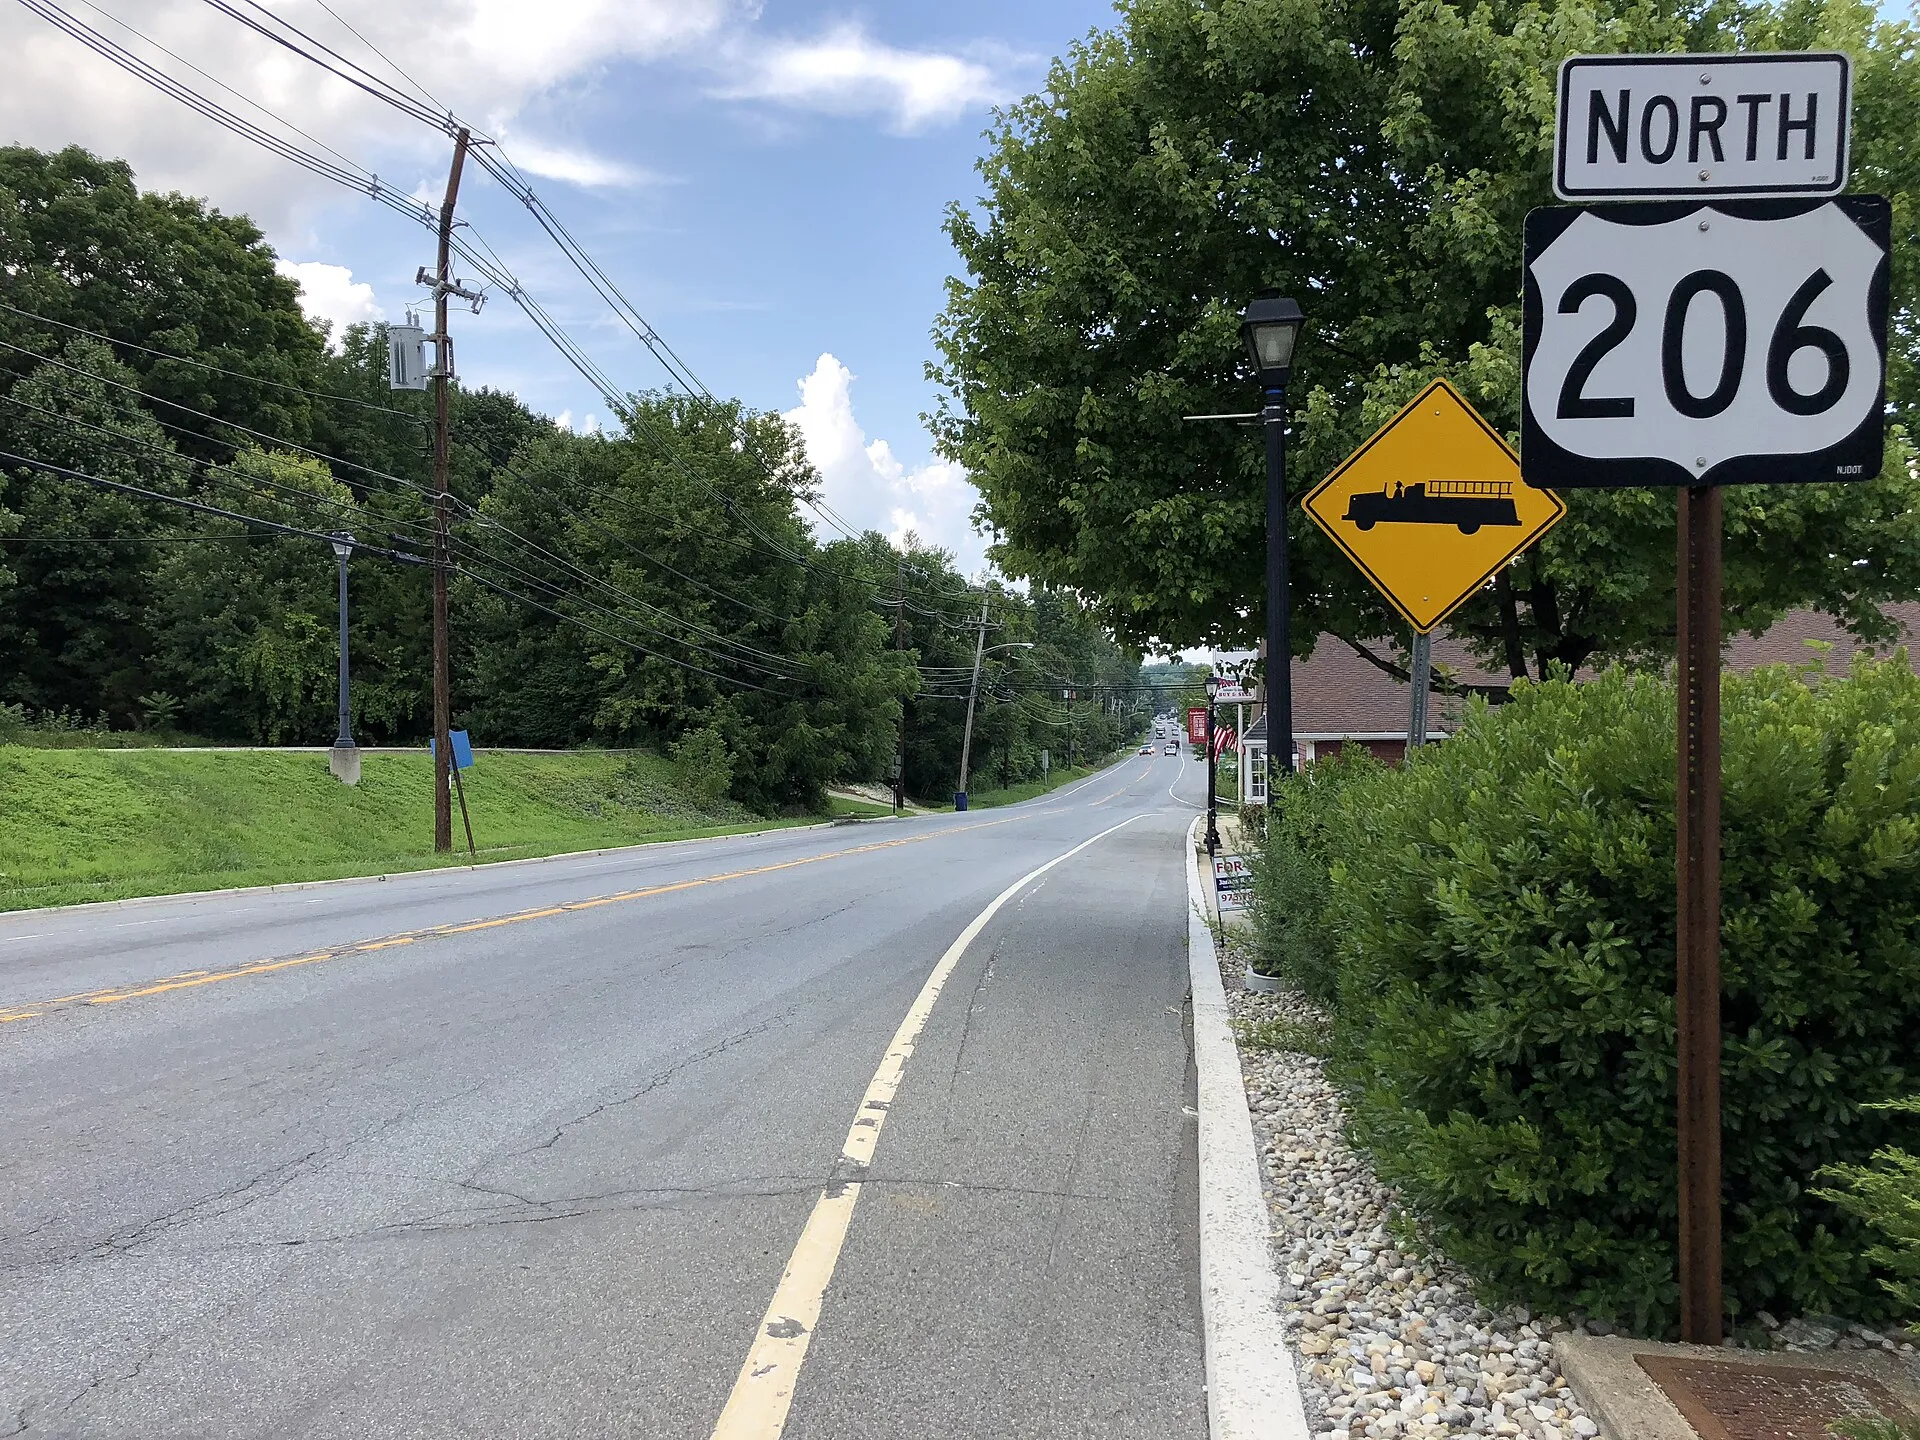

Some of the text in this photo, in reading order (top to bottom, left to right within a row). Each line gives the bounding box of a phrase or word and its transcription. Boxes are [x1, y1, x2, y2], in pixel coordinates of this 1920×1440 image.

[1586, 89, 1818, 164] NORTH
[1556, 267, 1850, 419] 206
[1836, 464, 1863, 475] NJDOT
[1216, 861, 1243, 873] FOR
